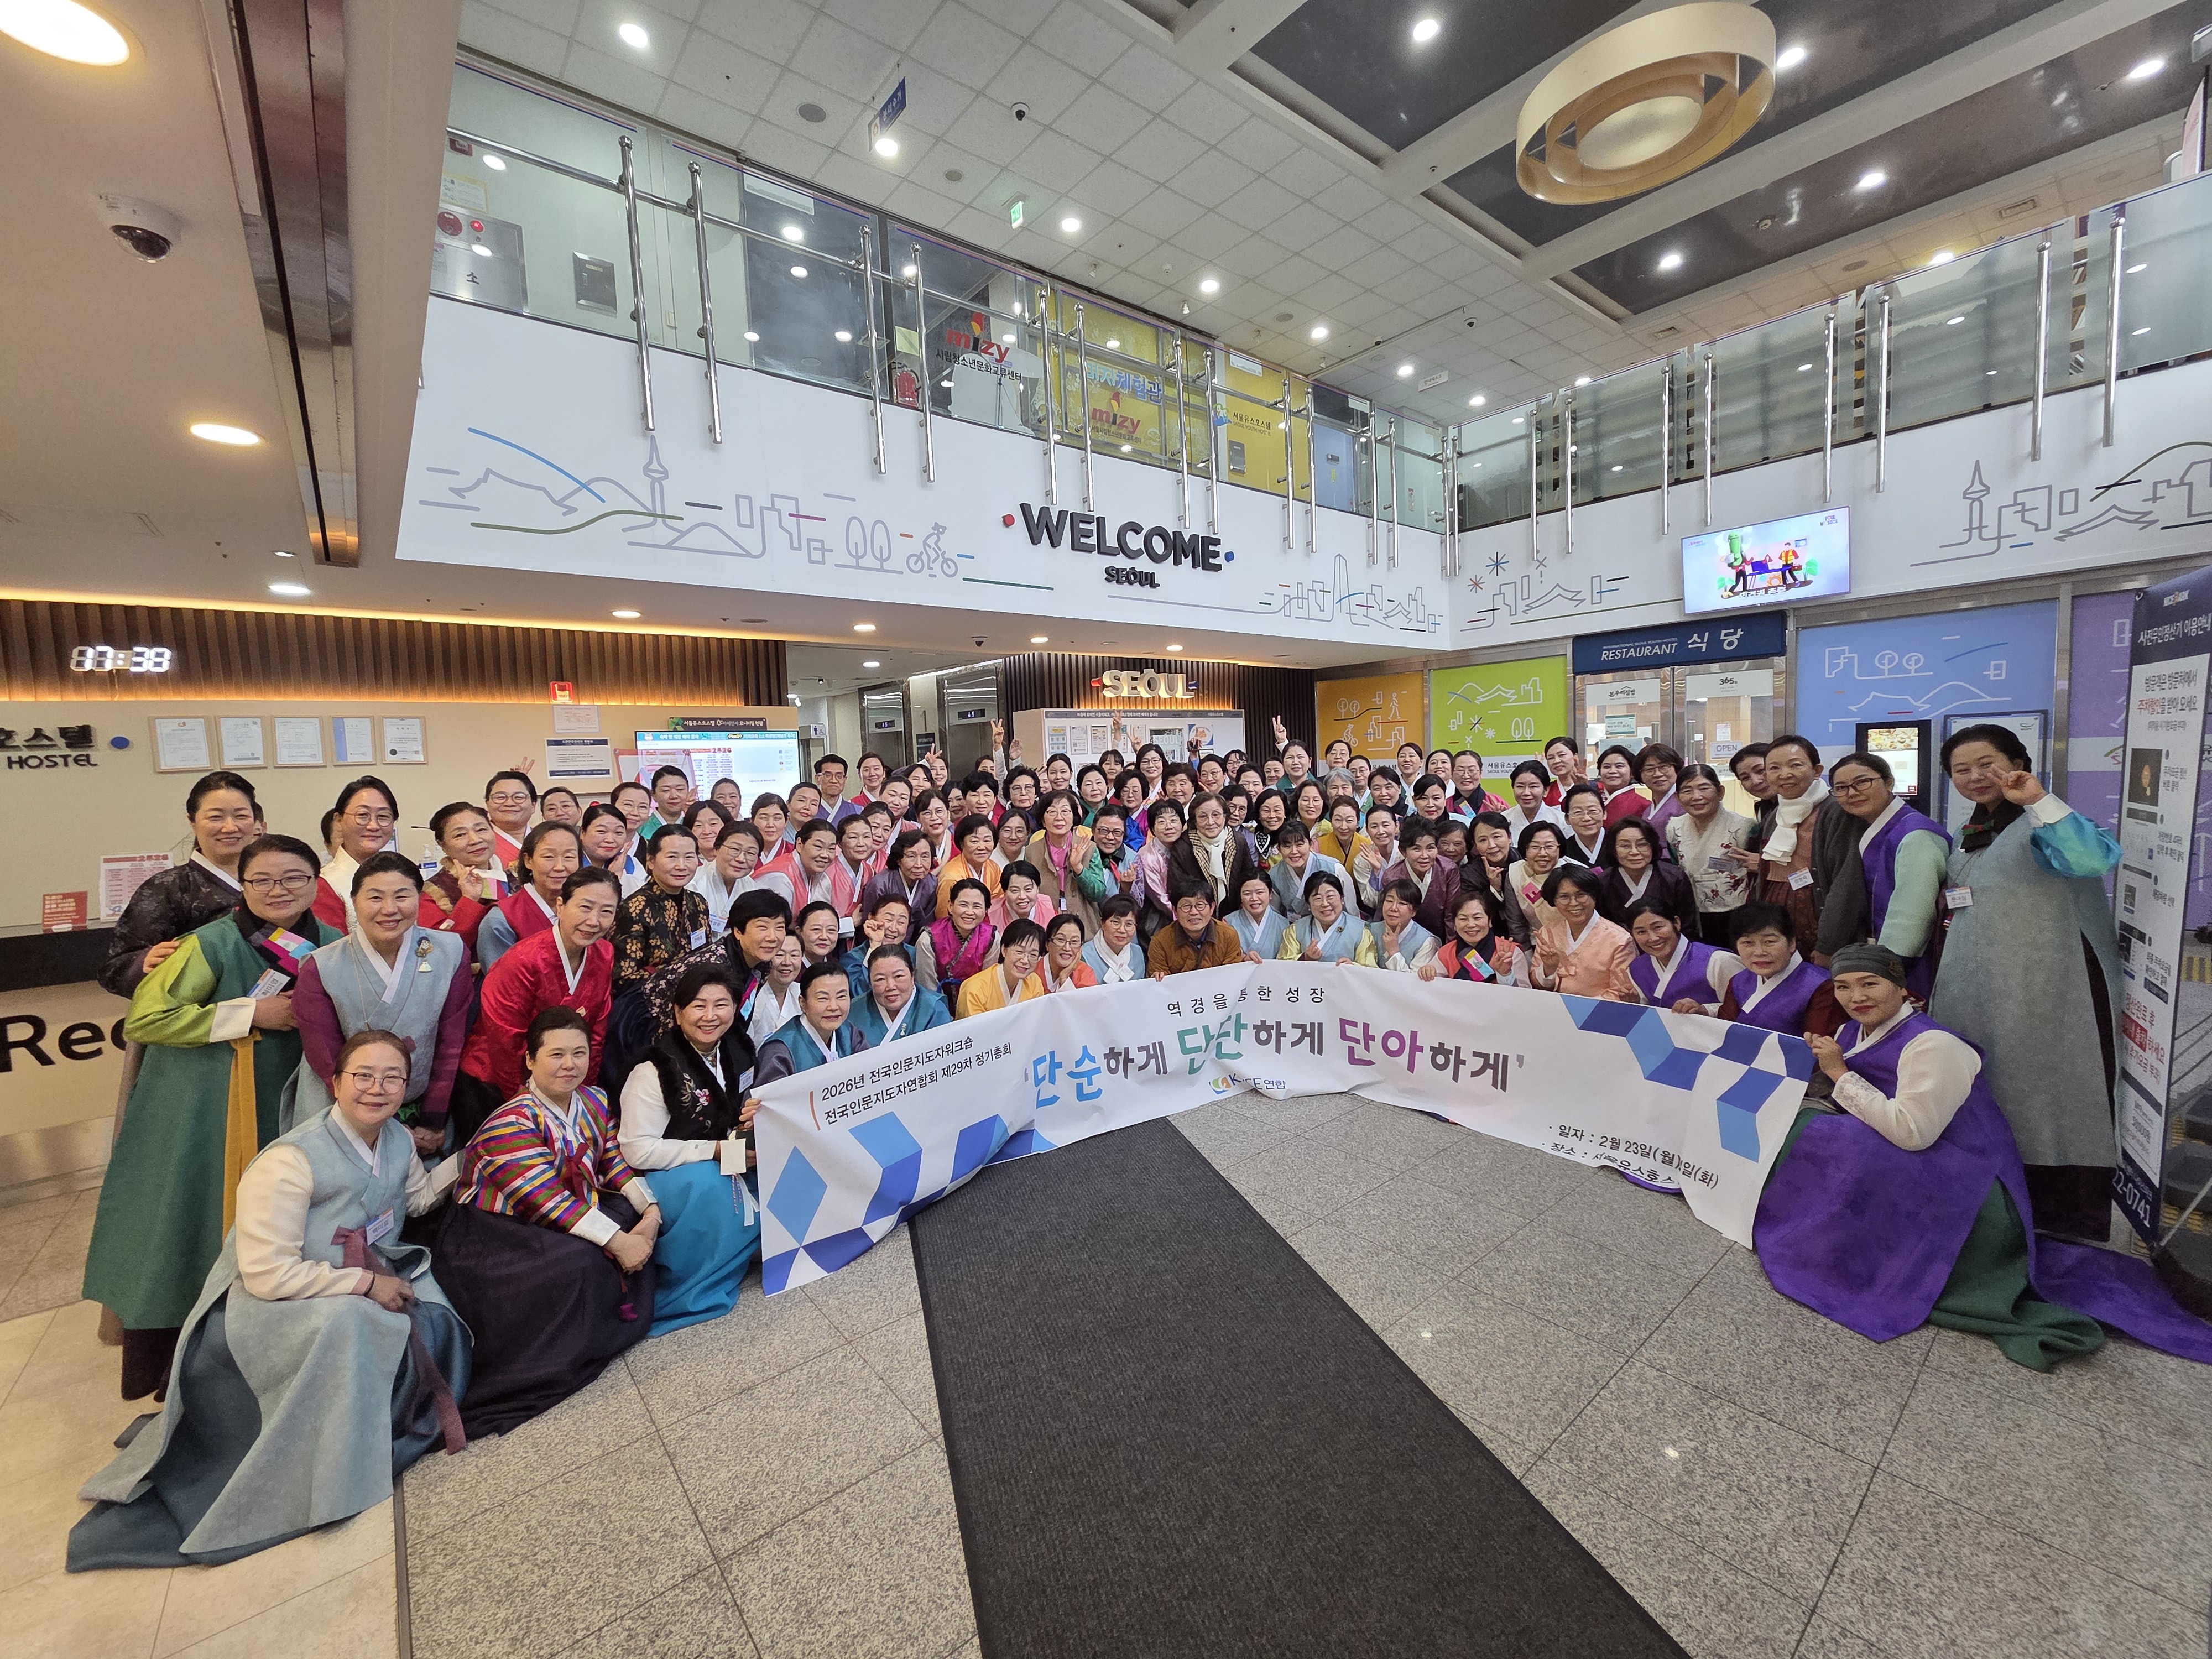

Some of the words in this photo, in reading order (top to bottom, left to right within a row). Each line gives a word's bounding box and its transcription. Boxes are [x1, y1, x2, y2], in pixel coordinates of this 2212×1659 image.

[946, 313, 1010, 363] mizy
[936, 348, 1022, 382] 시립청소년문화교류센터
[1092, 392, 1141, 434] mizy
[1019, 502, 1222, 572] WELCOME
[1105, 566, 1160, 588] SEOUL
[82, 645, 172, 673] 17:38
[1601, 643, 1678, 660] RESTAURANT
[1102, 668, 1194, 698] SEOUL
[7, 754, 98, 769] HOSTEL
[1167, 993, 1228, 1017] 역경을
[1286, 987, 1325, 1003] 성장
[1176, 1012, 1323, 1076] 단단하게
[821, 1073, 865, 1102] 2026년
[869, 1035, 973, 1084] 전국인문지도자워크숍
[824, 1070, 938, 1125] 전국인문지도자연합회
[941, 1056, 973, 1079] 제29차
[975, 1042, 1012, 1067] 정기총회
[1558, 1125, 1585, 1142] 일자
[1598, 1135, 1621, 1151] 2월
[1550, 1142, 1576, 1156] 장소
[1592, 1152, 1680, 1185] 서울유스호스
